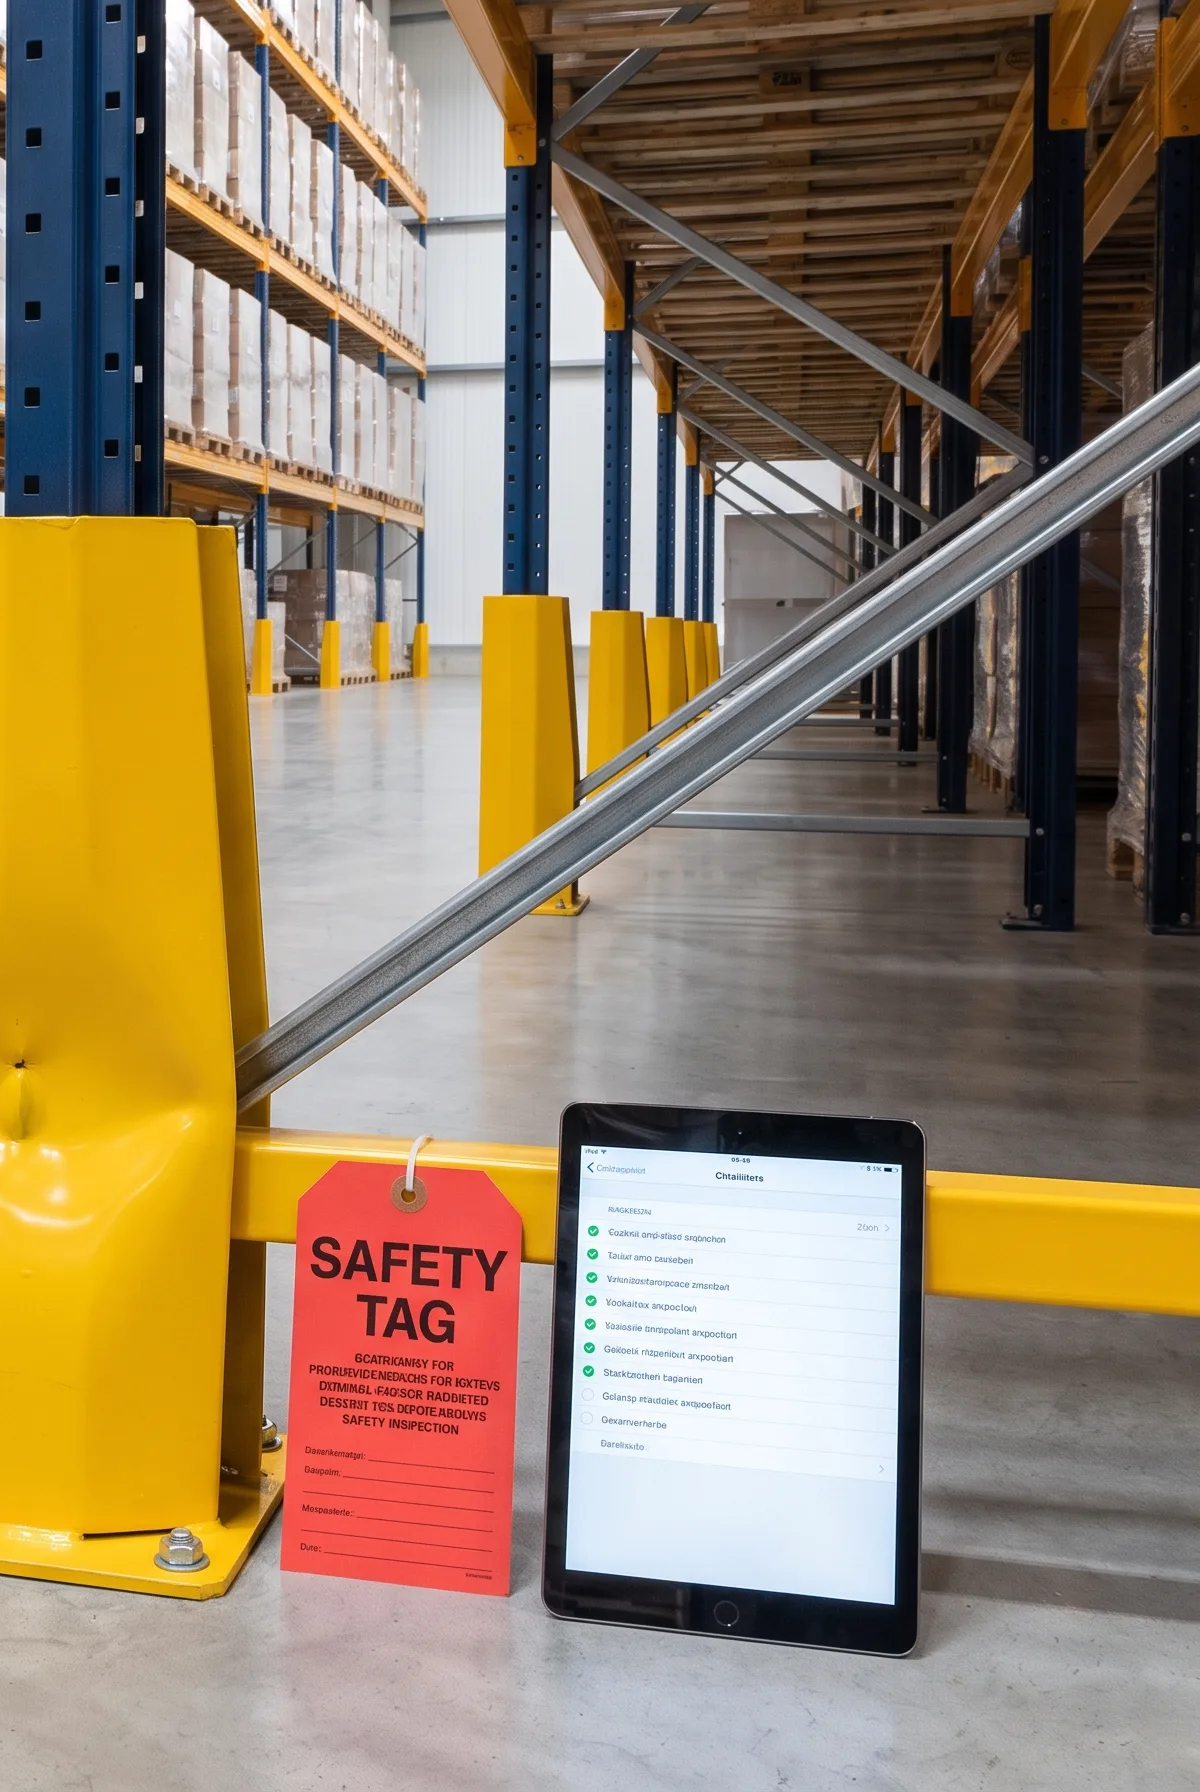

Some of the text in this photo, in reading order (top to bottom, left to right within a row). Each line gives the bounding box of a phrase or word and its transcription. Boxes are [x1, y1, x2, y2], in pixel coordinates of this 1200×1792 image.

[310, 1235, 509, 1292] SAFETY
[356, 1294, 456, 1344] TAG
[432, 1360, 454, 1371] FOR
[430, 1375, 453, 1387] FOR
[342, 1413, 385, 1427] SAFETY
